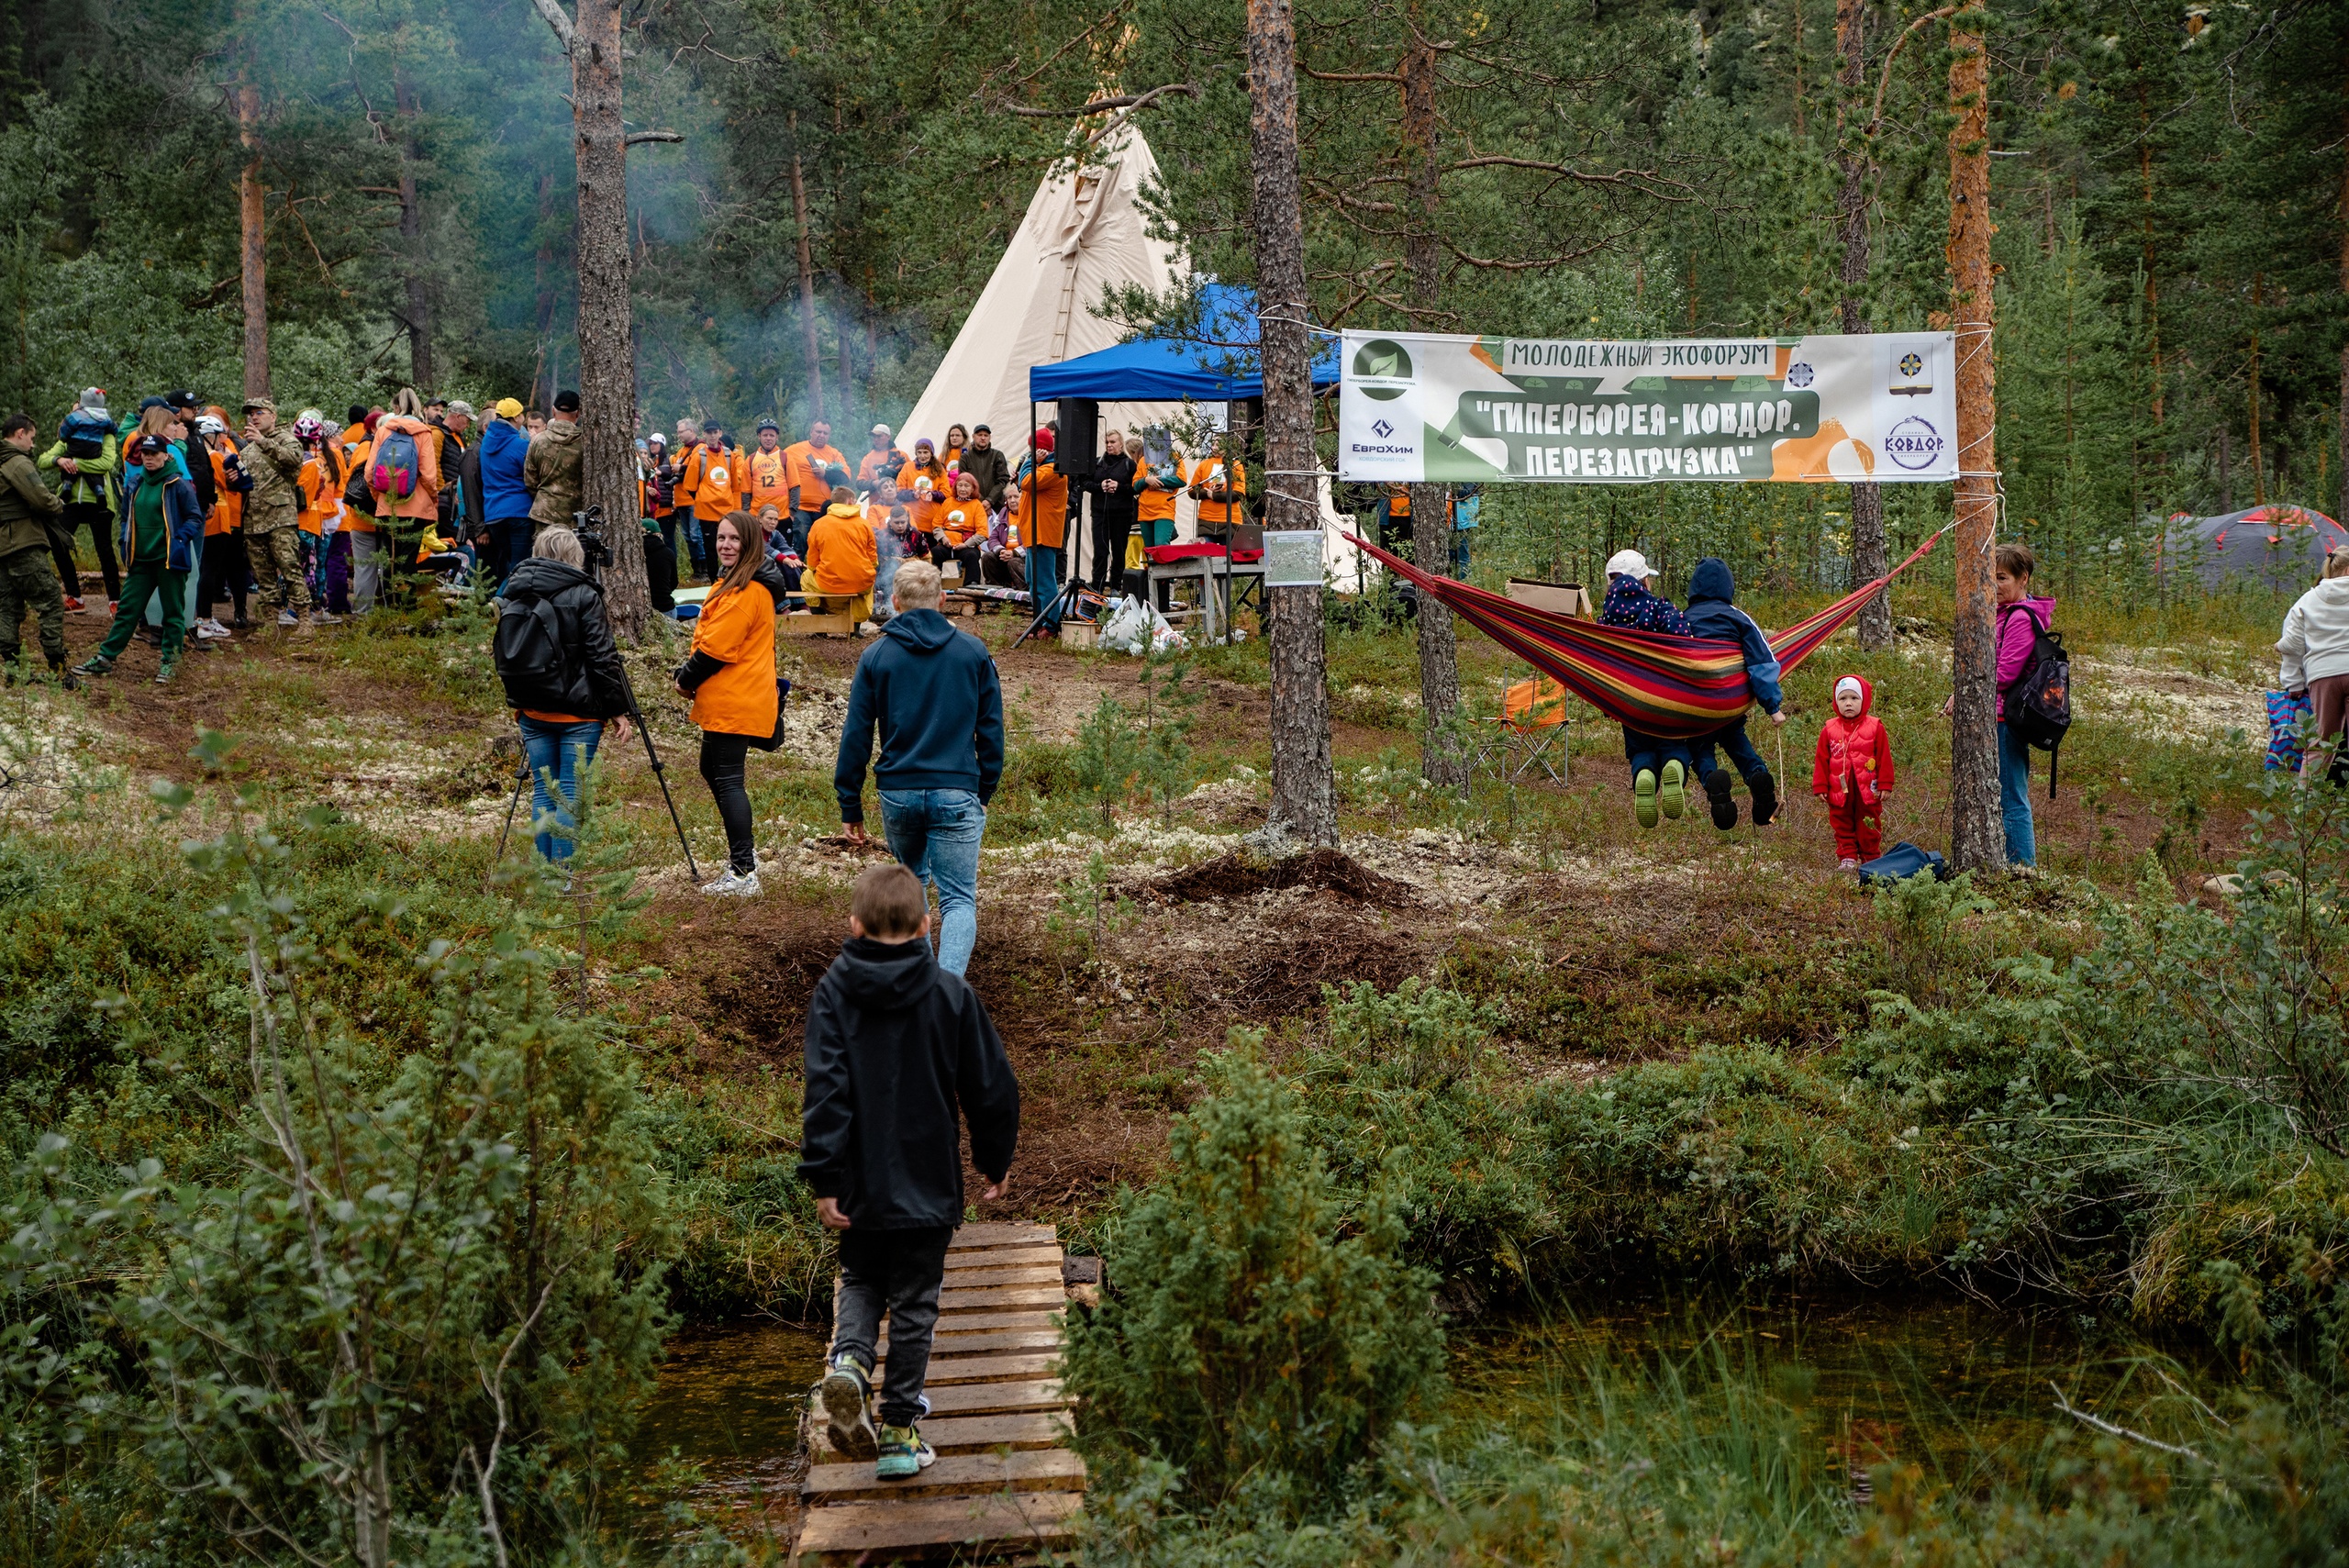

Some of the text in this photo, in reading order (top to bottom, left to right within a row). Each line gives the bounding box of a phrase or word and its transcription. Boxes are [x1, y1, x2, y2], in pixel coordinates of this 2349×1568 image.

[1511, 342, 1769, 369] МОЛОДЕЖНЫЙ ЭКОФОРУМ
[761, 476, 774, 487] 12
